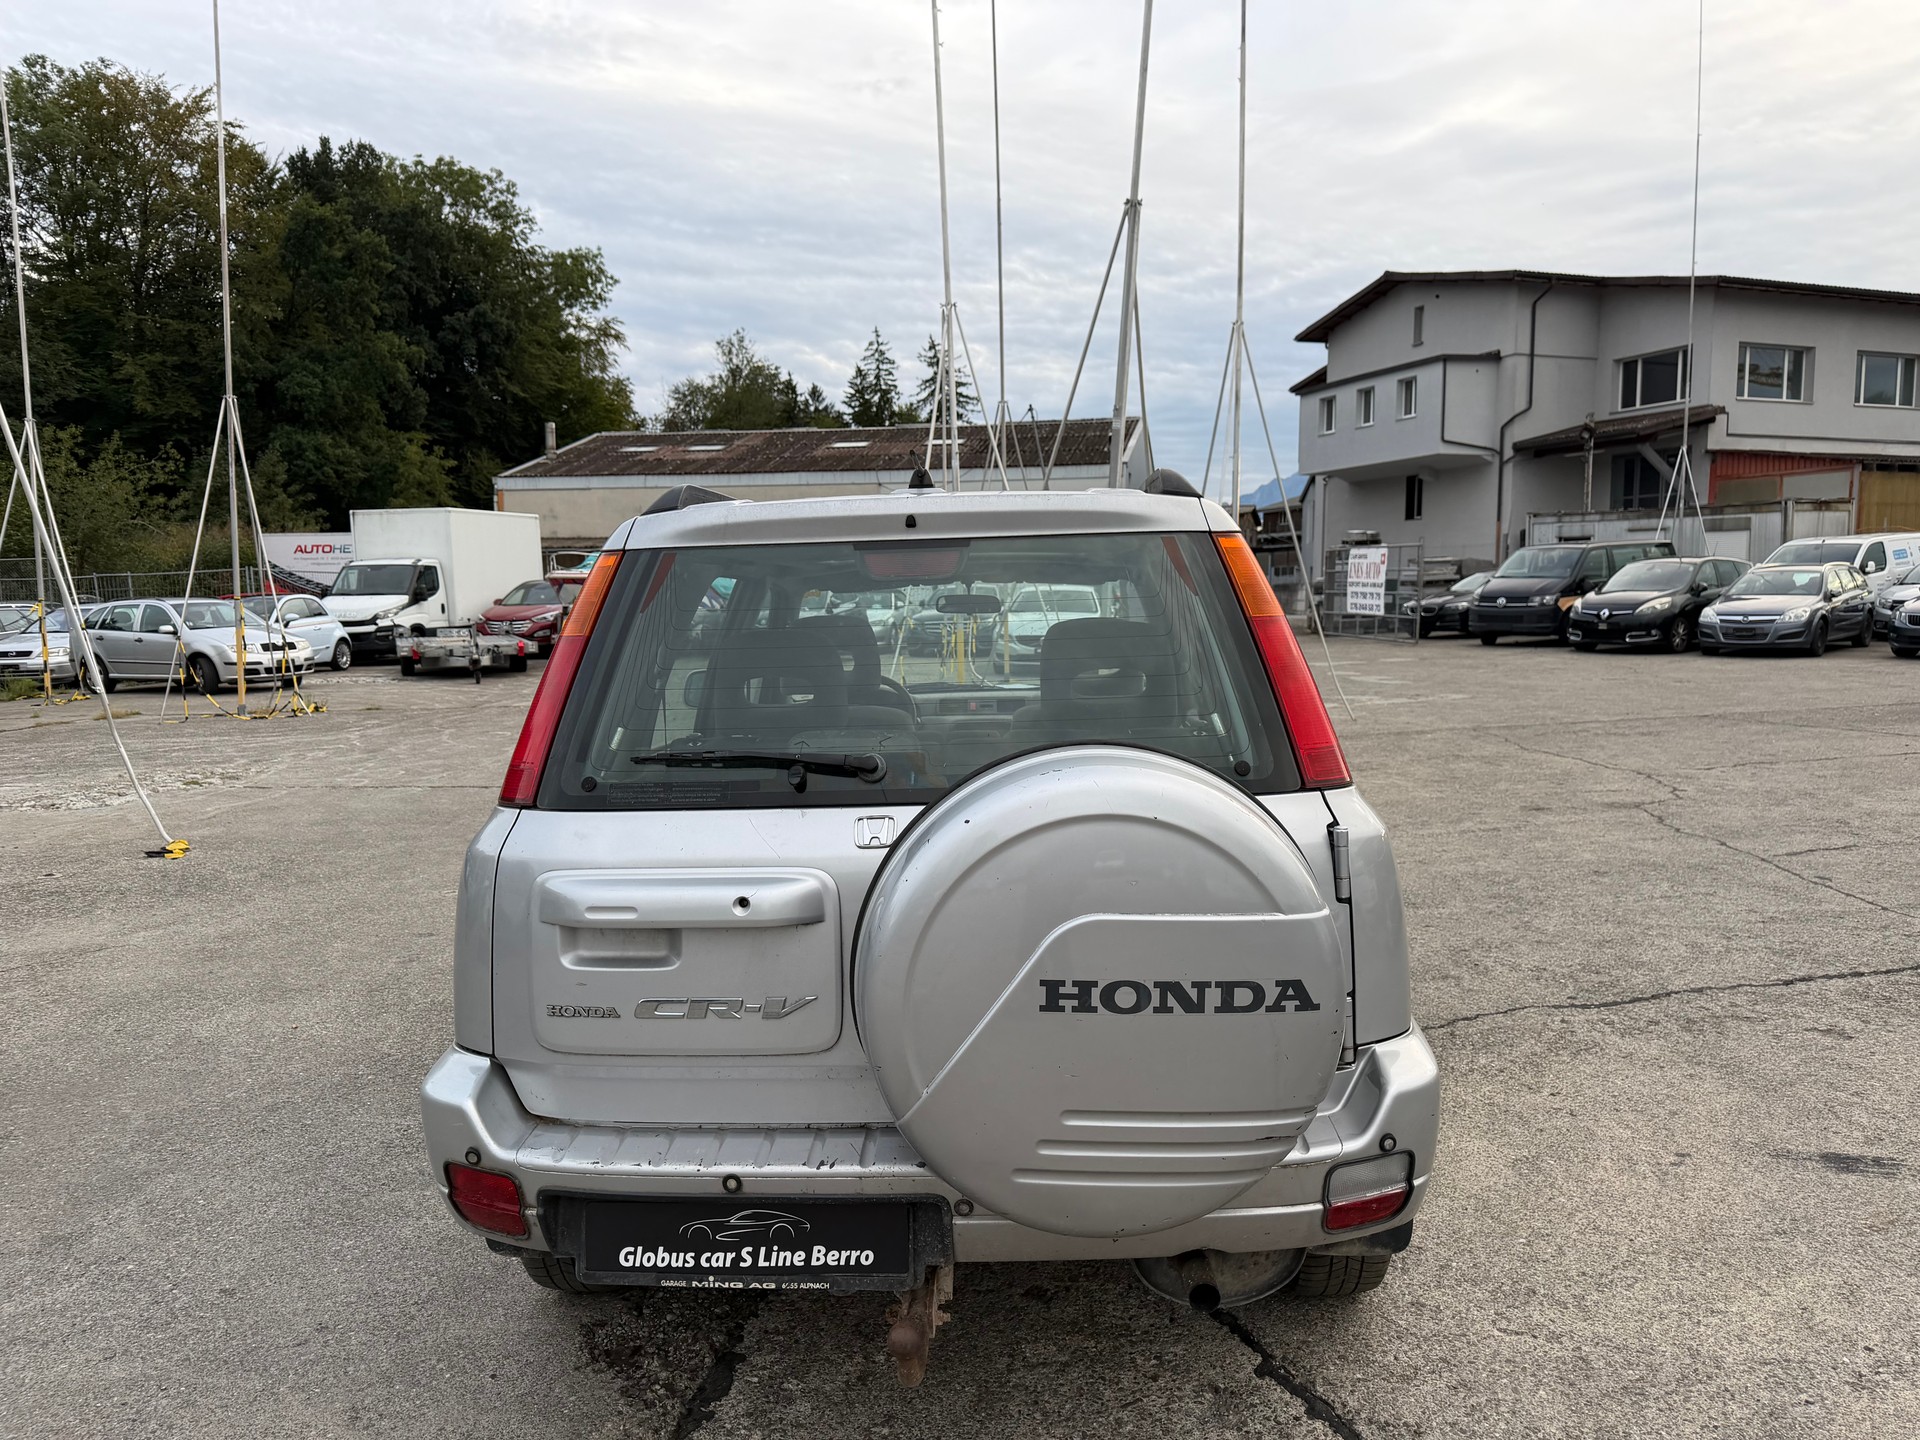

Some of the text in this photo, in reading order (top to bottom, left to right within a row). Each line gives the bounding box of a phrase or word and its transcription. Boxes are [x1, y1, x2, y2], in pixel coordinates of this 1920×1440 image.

[293, 544, 354, 554] AUTOHE
[1364, 562, 1381, 580] AUTO
[546, 995, 819, 1019] HONDA CR-V
[1039, 979, 1321, 1015] HONDA
[618, 1245, 874, 1267] Globus car S Line Berro
